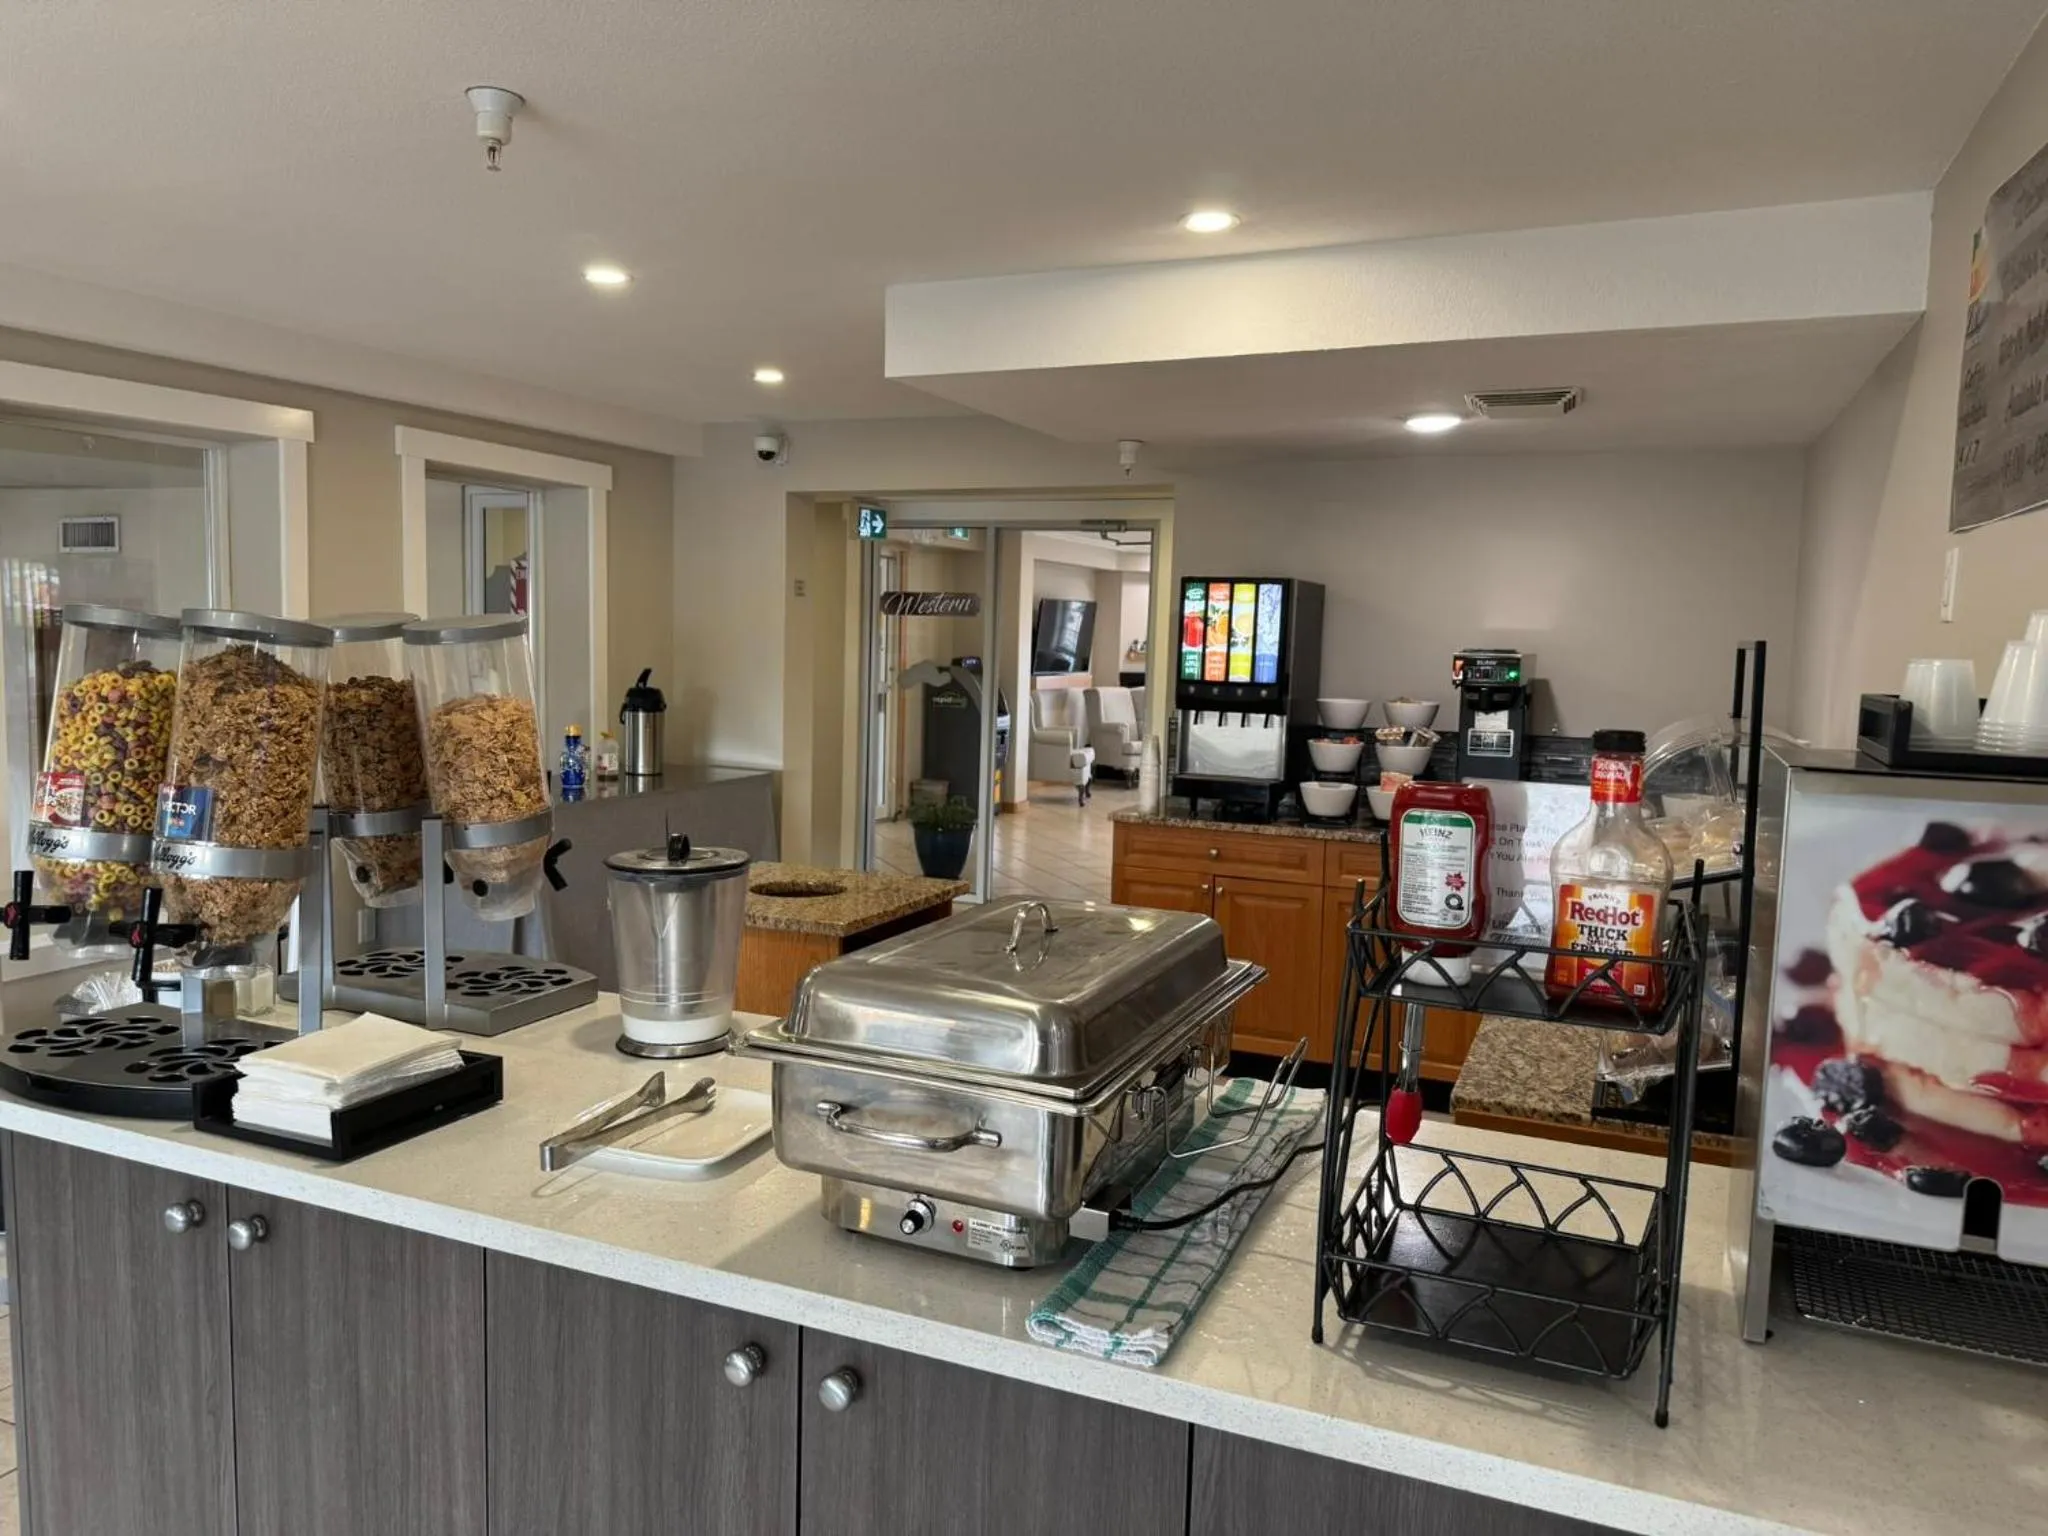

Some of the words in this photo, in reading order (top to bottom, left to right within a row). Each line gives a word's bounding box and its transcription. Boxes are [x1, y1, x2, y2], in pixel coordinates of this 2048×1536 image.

[884, 590, 971, 616] Western
[31, 828, 70, 854] llogg's
[1419, 827, 1454, 840] HEINZ
[155, 841, 197, 870] llogg's
[1577, 924, 1628, 941] THICK
